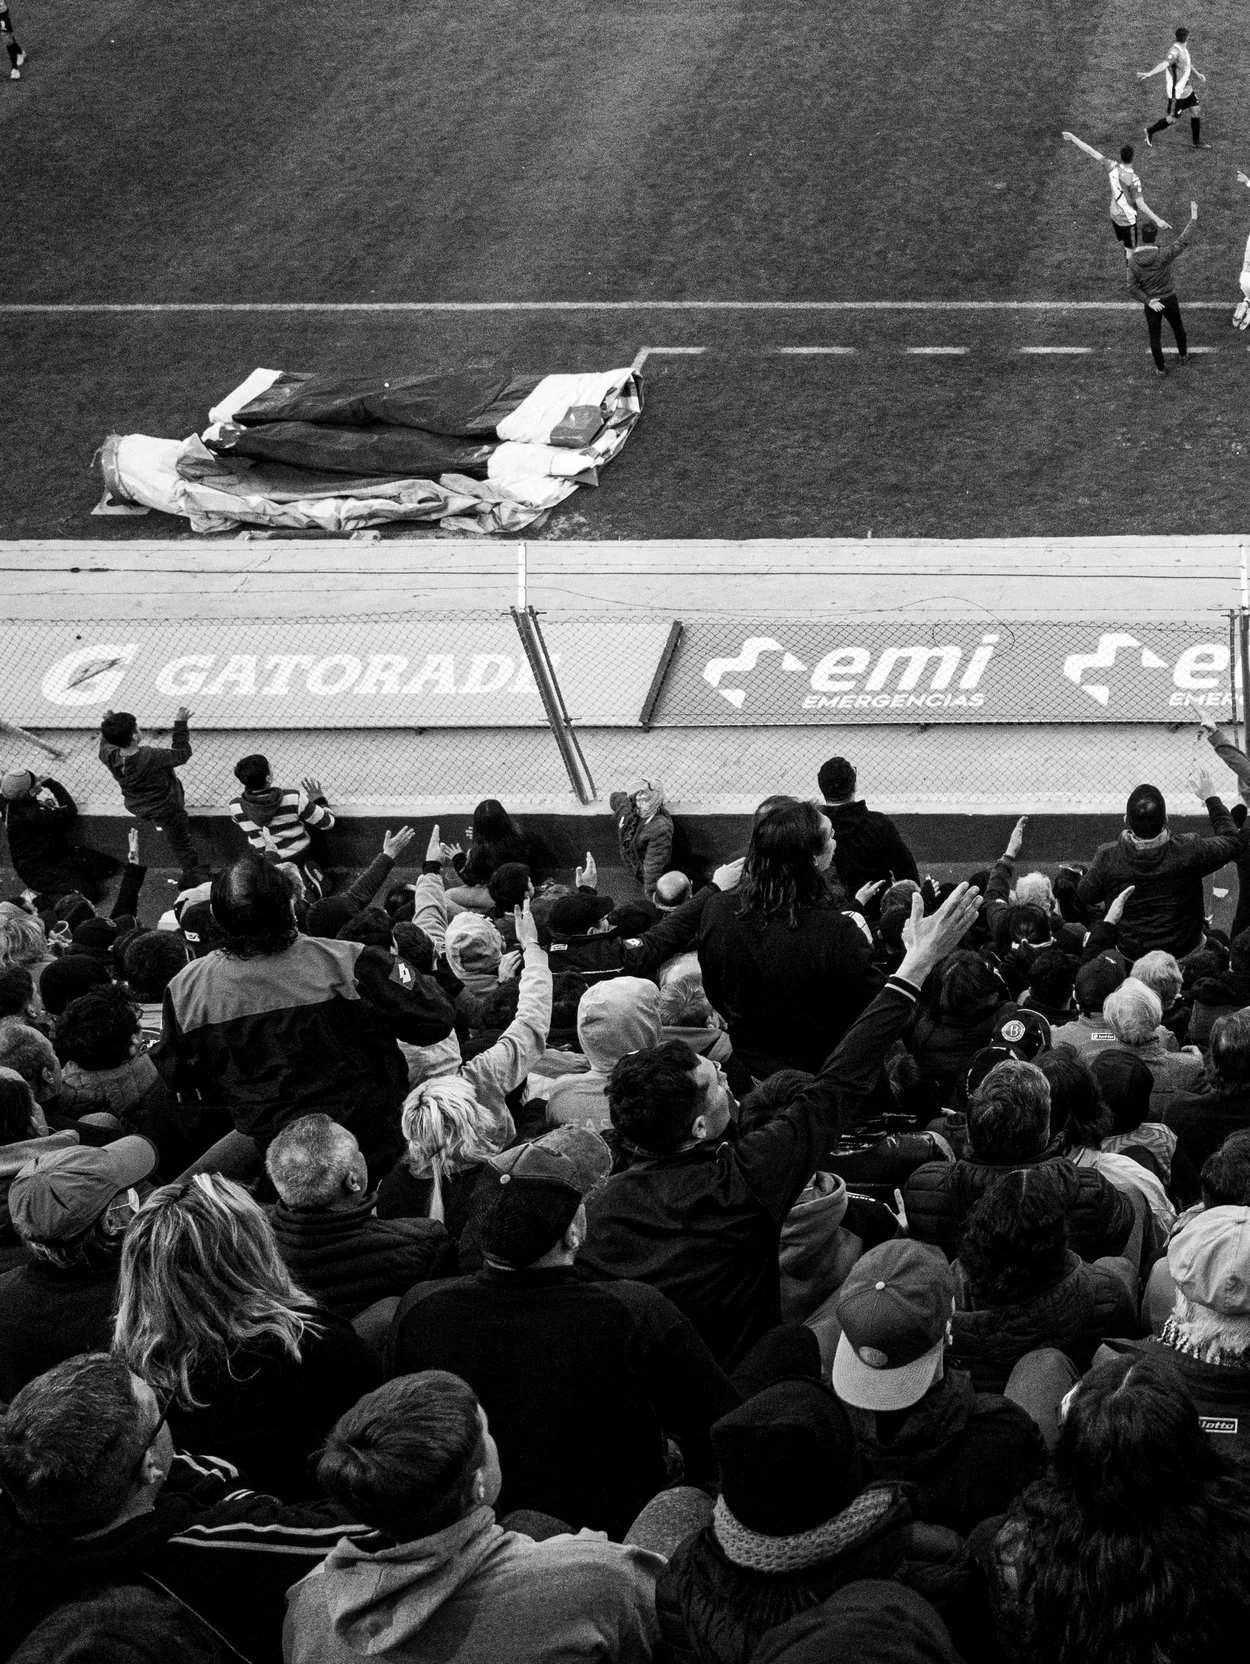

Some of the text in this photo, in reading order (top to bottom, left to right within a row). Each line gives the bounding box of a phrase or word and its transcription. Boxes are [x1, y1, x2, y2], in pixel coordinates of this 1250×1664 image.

[810, 633, 1000, 693] emi
[801, 692, 985, 709] EMERGENCIAS
[1201, 1421, 1234, 1429] lotto
